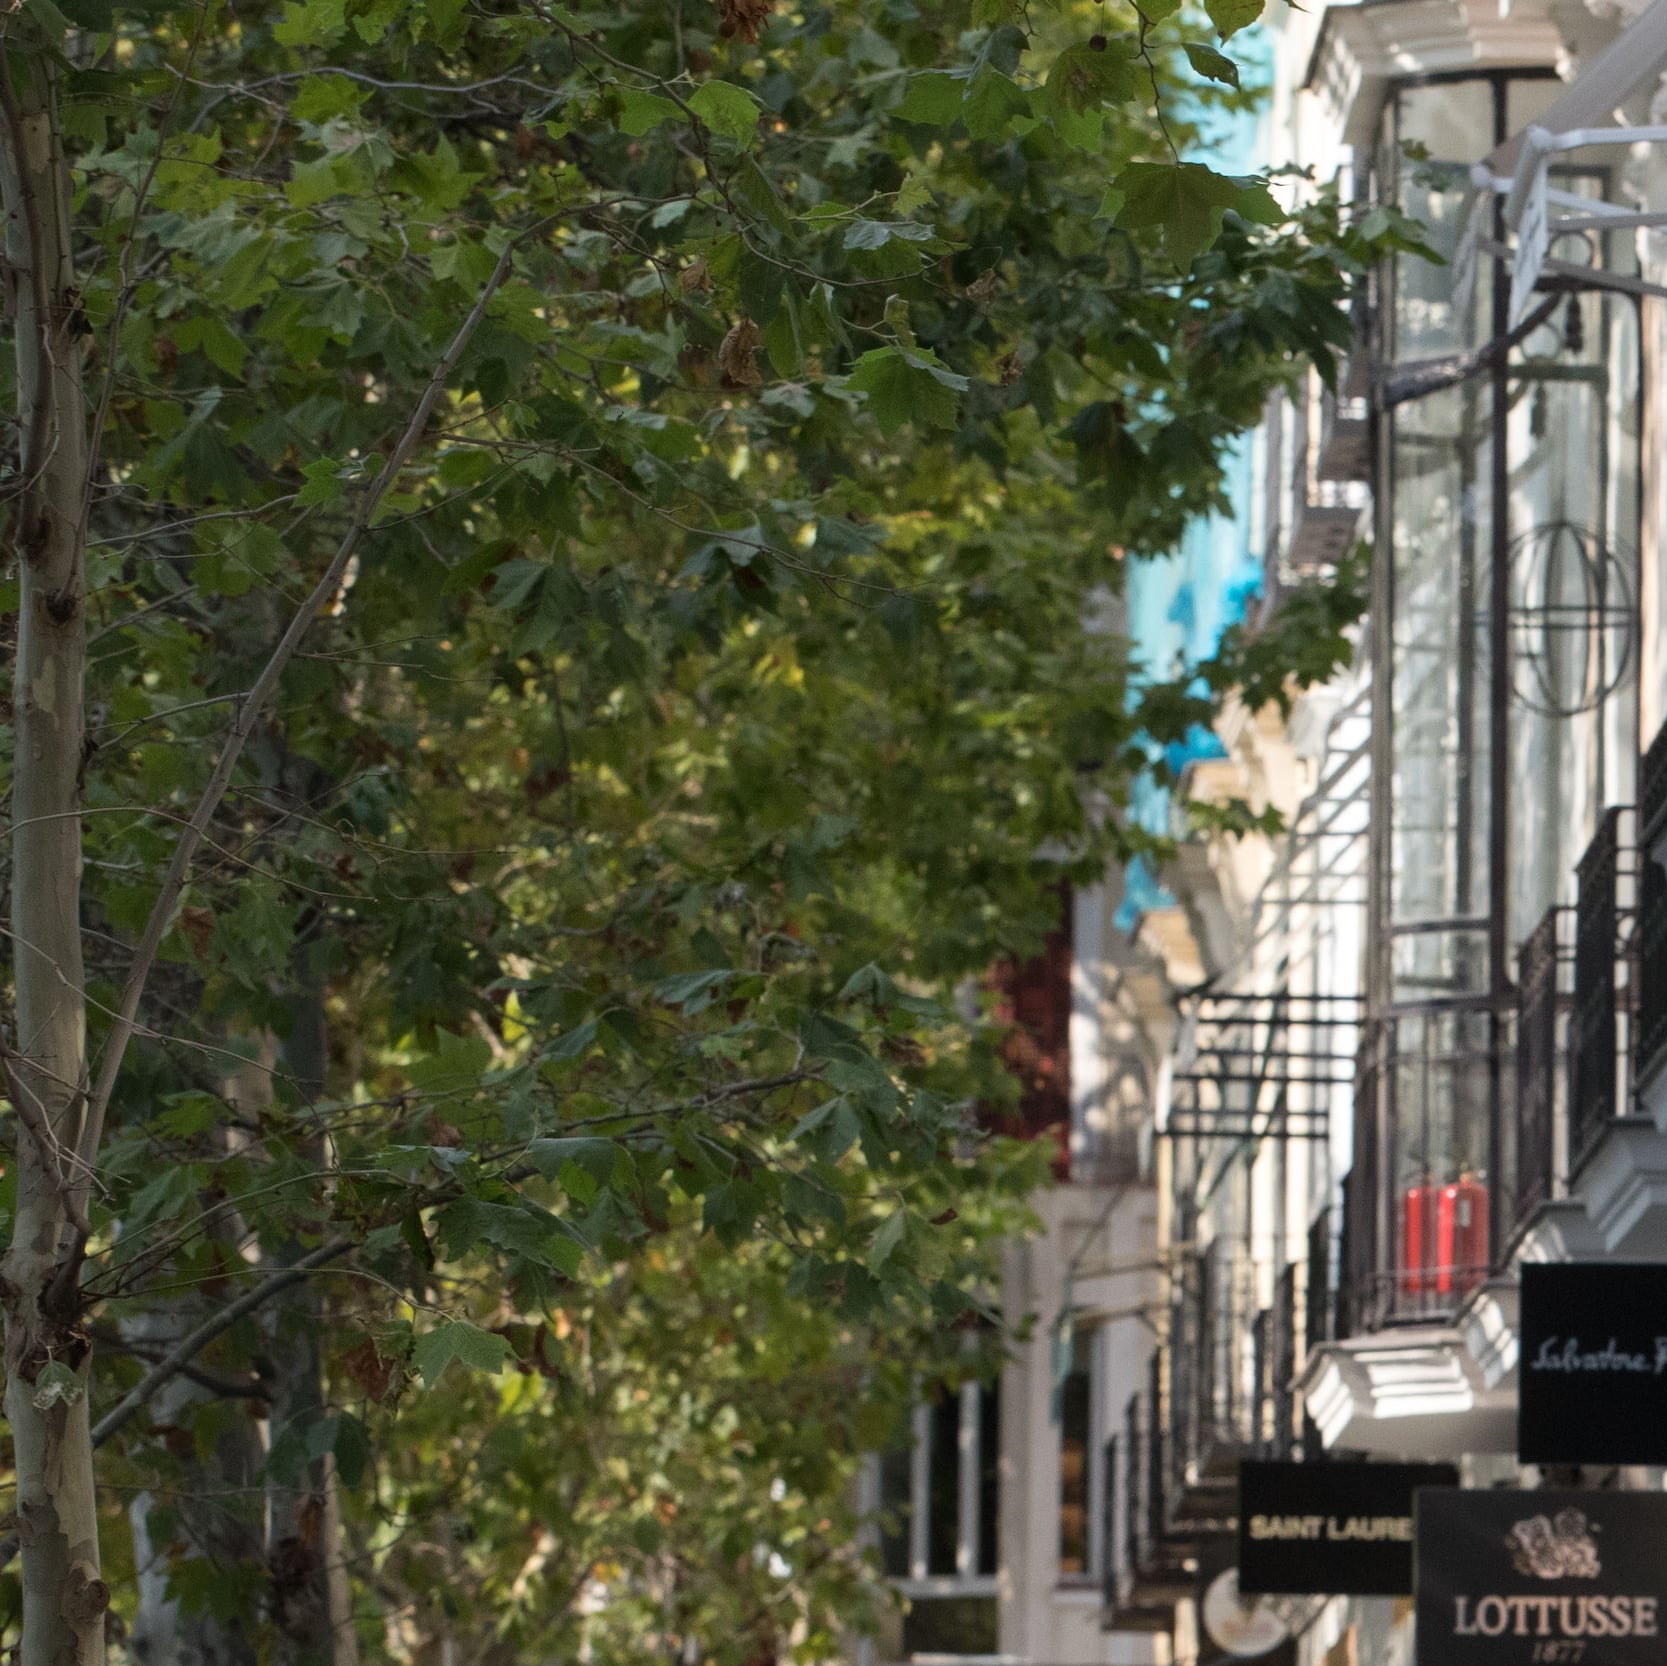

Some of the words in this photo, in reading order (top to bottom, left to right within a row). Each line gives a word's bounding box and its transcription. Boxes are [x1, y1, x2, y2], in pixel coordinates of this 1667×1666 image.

[1531, 1335, 1651, 1374] Salvatore
[1249, 1514, 1325, 1541] SAINT
[1326, 1516, 1414, 1542] LAURE
[1453, 1594, 1659, 1636] LOTTUSSE
[1530, 1641, 1588, 1664] 1877
